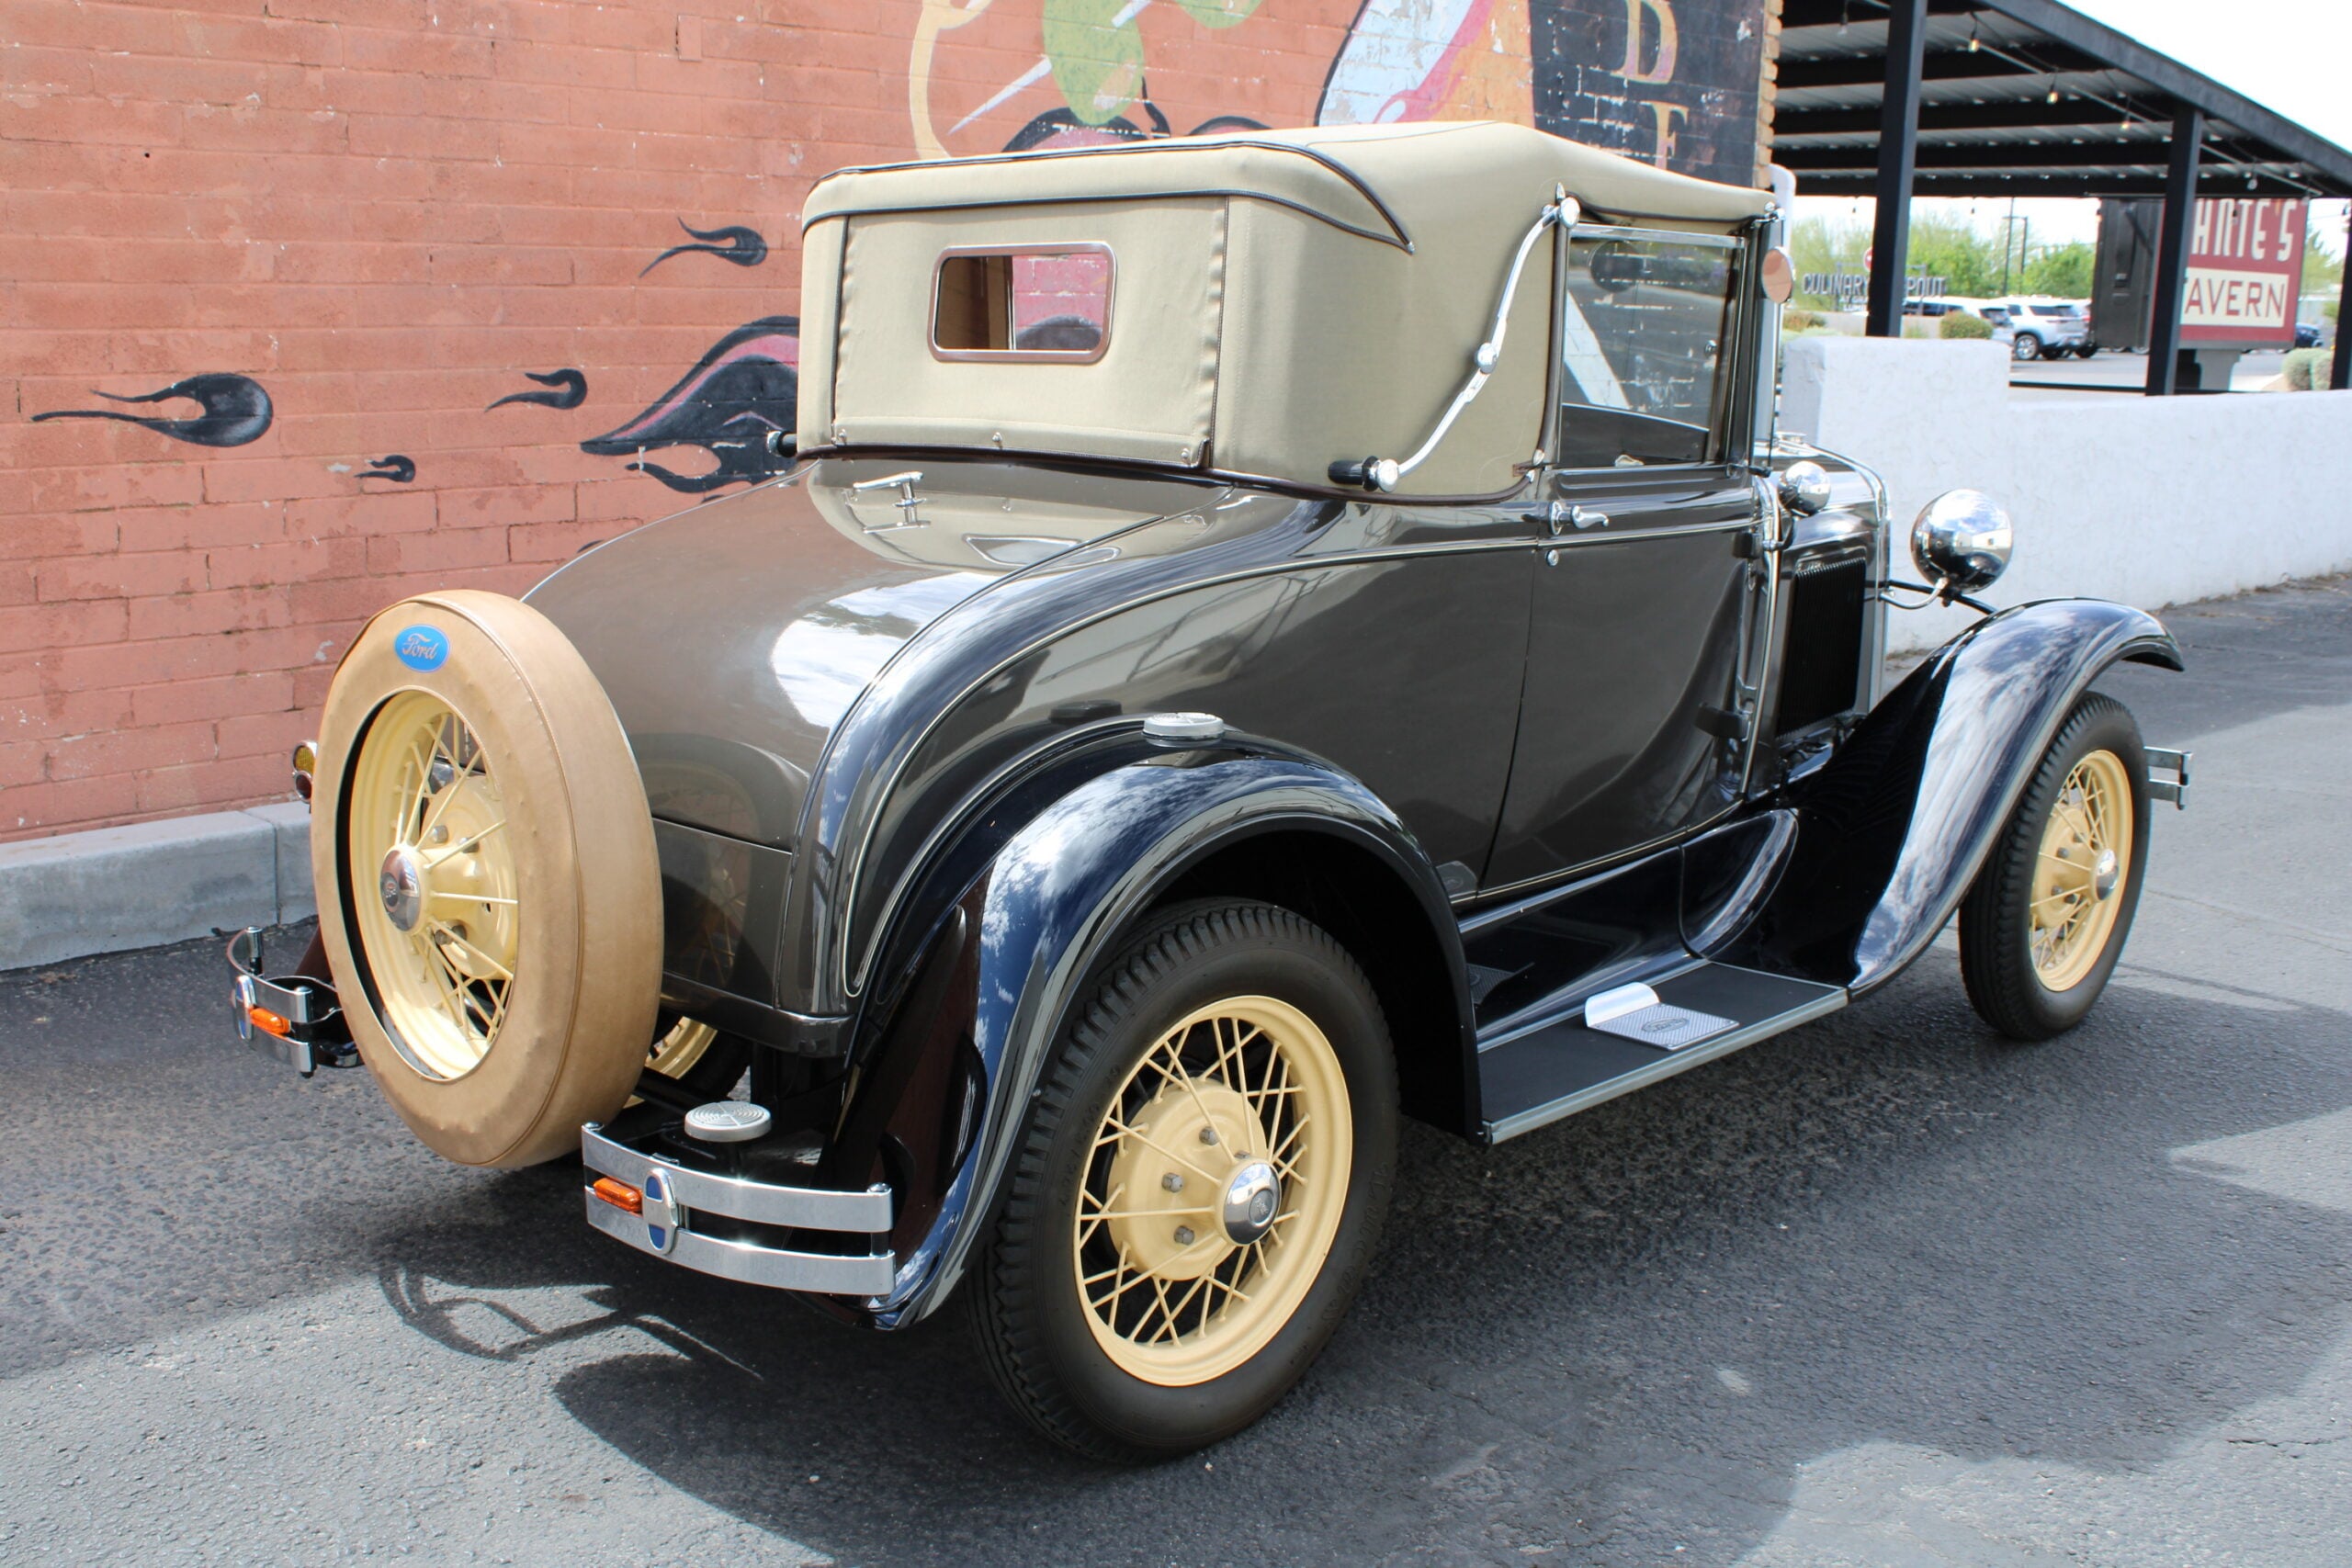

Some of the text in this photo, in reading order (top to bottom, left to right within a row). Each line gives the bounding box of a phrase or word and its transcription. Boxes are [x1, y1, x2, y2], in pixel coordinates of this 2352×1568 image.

[1906, 276, 1947, 298] POUT
[2185, 277, 2285, 318] AVERN
[402, 632, 439, 660] Ford
